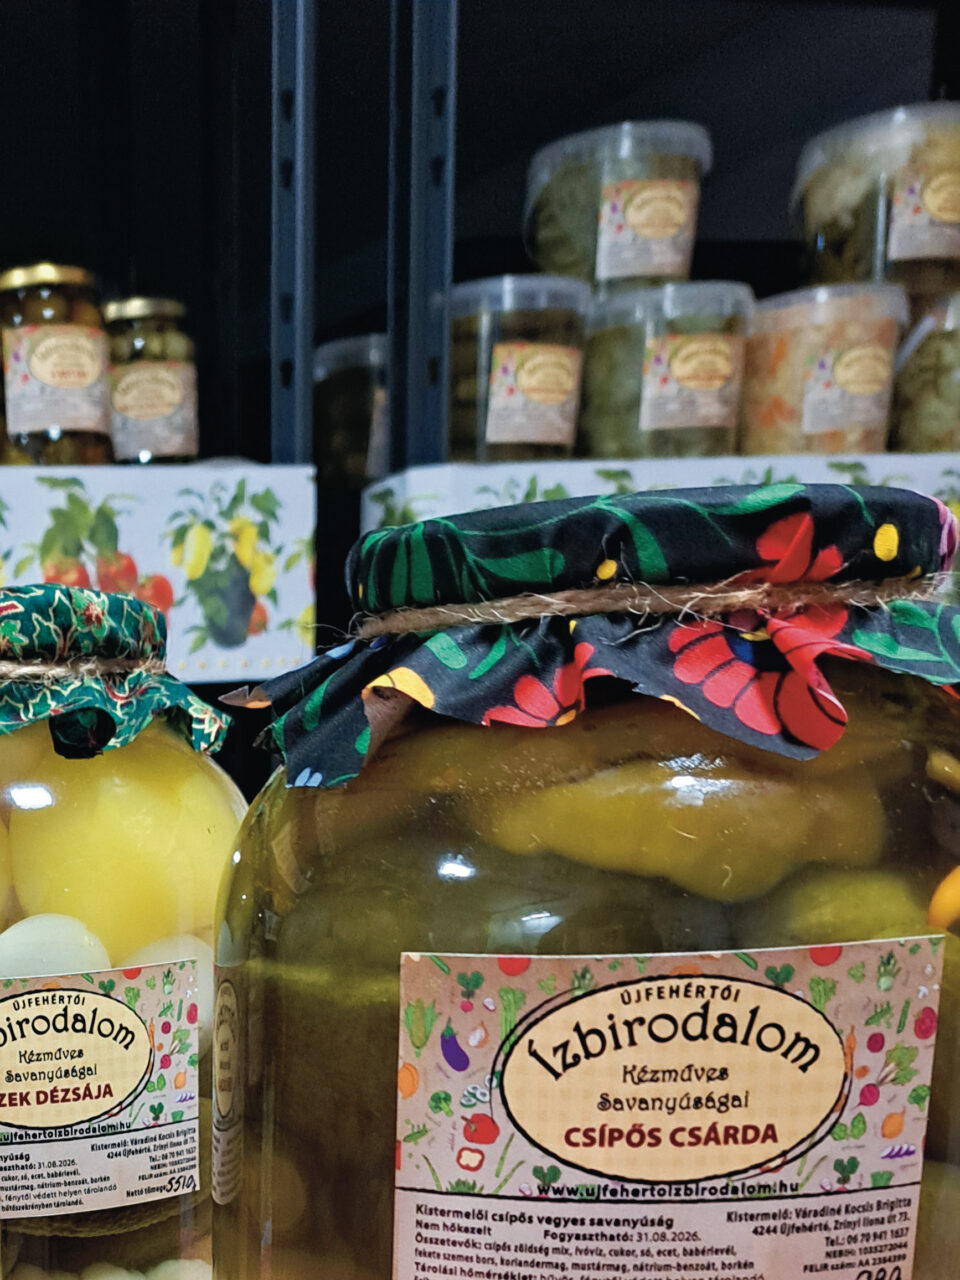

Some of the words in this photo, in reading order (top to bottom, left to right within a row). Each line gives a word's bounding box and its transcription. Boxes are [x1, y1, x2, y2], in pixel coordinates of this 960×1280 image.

[13, 994, 85, 1011] ÚJFEHÉRTÓI
[620, 982, 740, 1005] ÚJFEHÉRTÓI
[528, 1000, 820, 1080] Ízbirodalom
[19, 1048, 84, 1064] Kézműves
[5, 1064, 97, 1083] Savanyúságai
[622, 1064, 729, 1085] Kézműves
[36, 1083, 114, 1106] DÉZSÁJA
[597, 1091, 750, 1115] Savanyúságai
[564, 1123, 662, 1148] CSÍPŐS
[669, 1122, 778, 1148] CSÁRDA
[415, 1219, 440, 1231] Nem
[416, 1204, 488, 1221] Kistermelői
[491, 1212, 534, 1225] csípős
[537, 1216, 586, 1228] vegyes
[589, 1215, 674, 1229] savanyúság
[544, 1230, 634, 1242] Fogyasztható:
[636, 1232, 702, 1242] 31.08.2026.
[752, 1224, 777, 1236] 4244
[415, 1233, 482, 1249] Összetevők:
[414, 1262, 457, 1276] Tárolási
